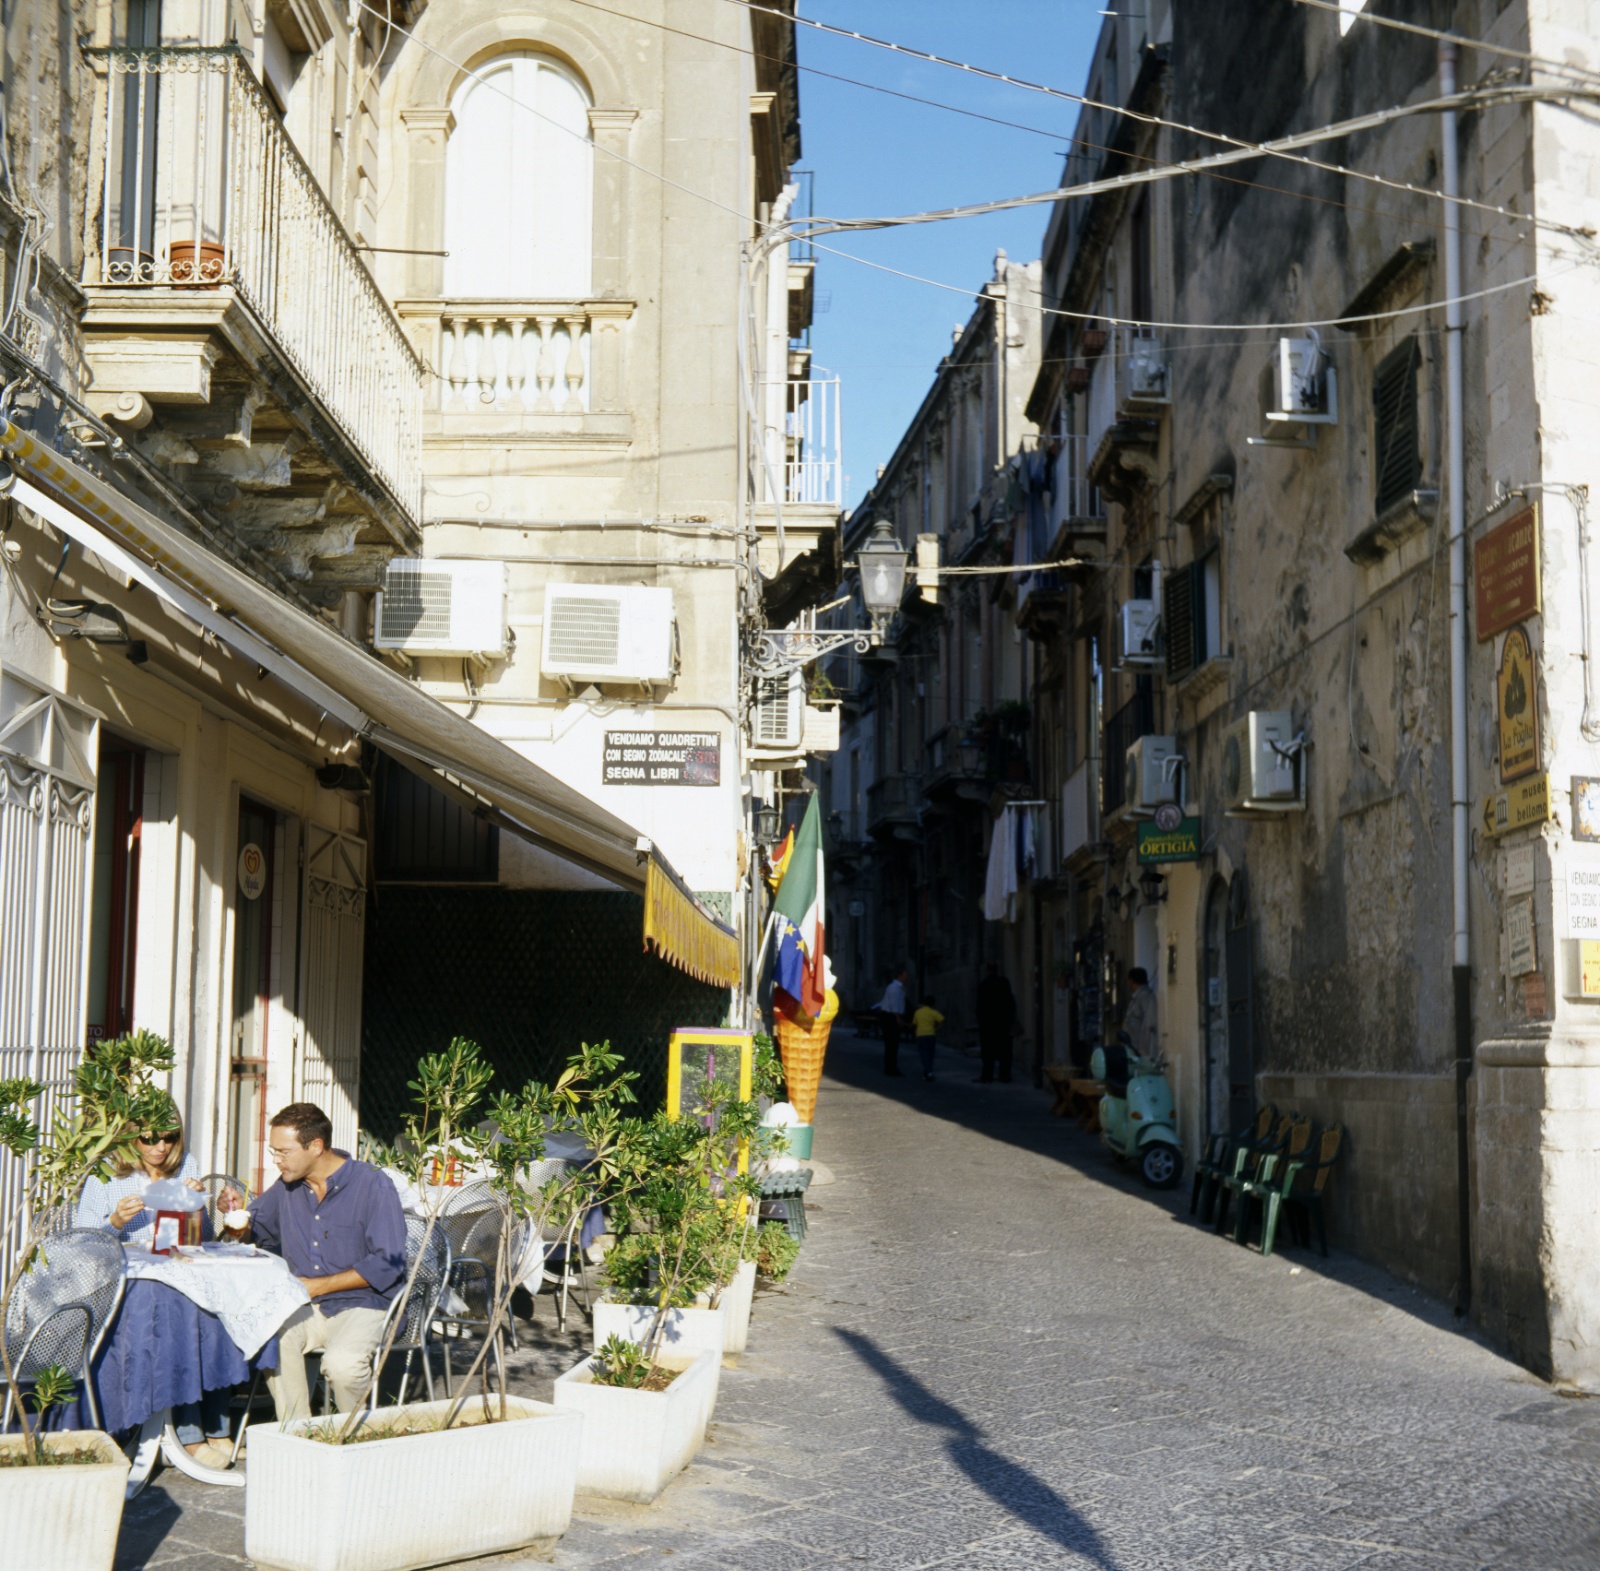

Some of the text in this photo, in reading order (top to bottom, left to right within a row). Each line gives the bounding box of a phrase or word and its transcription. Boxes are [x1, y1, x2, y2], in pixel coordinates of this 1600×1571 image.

[608, 732, 718, 747] VENDIAMO QUADRETTINI
[605, 748, 621, 761] CON
[623, 749, 647, 762] SEGNO
[648, 749, 686, 763] ZODIACALE
[606, 766, 646, 779] SEGNA
[650, 768, 679, 779] LIBRI
[1521, 780, 1547, 800] museo
[1516, 801, 1547, 822] bellomo
[1139, 840, 1197, 856] ORTIGIA
[1571, 915, 1598, 929] SEGNA
